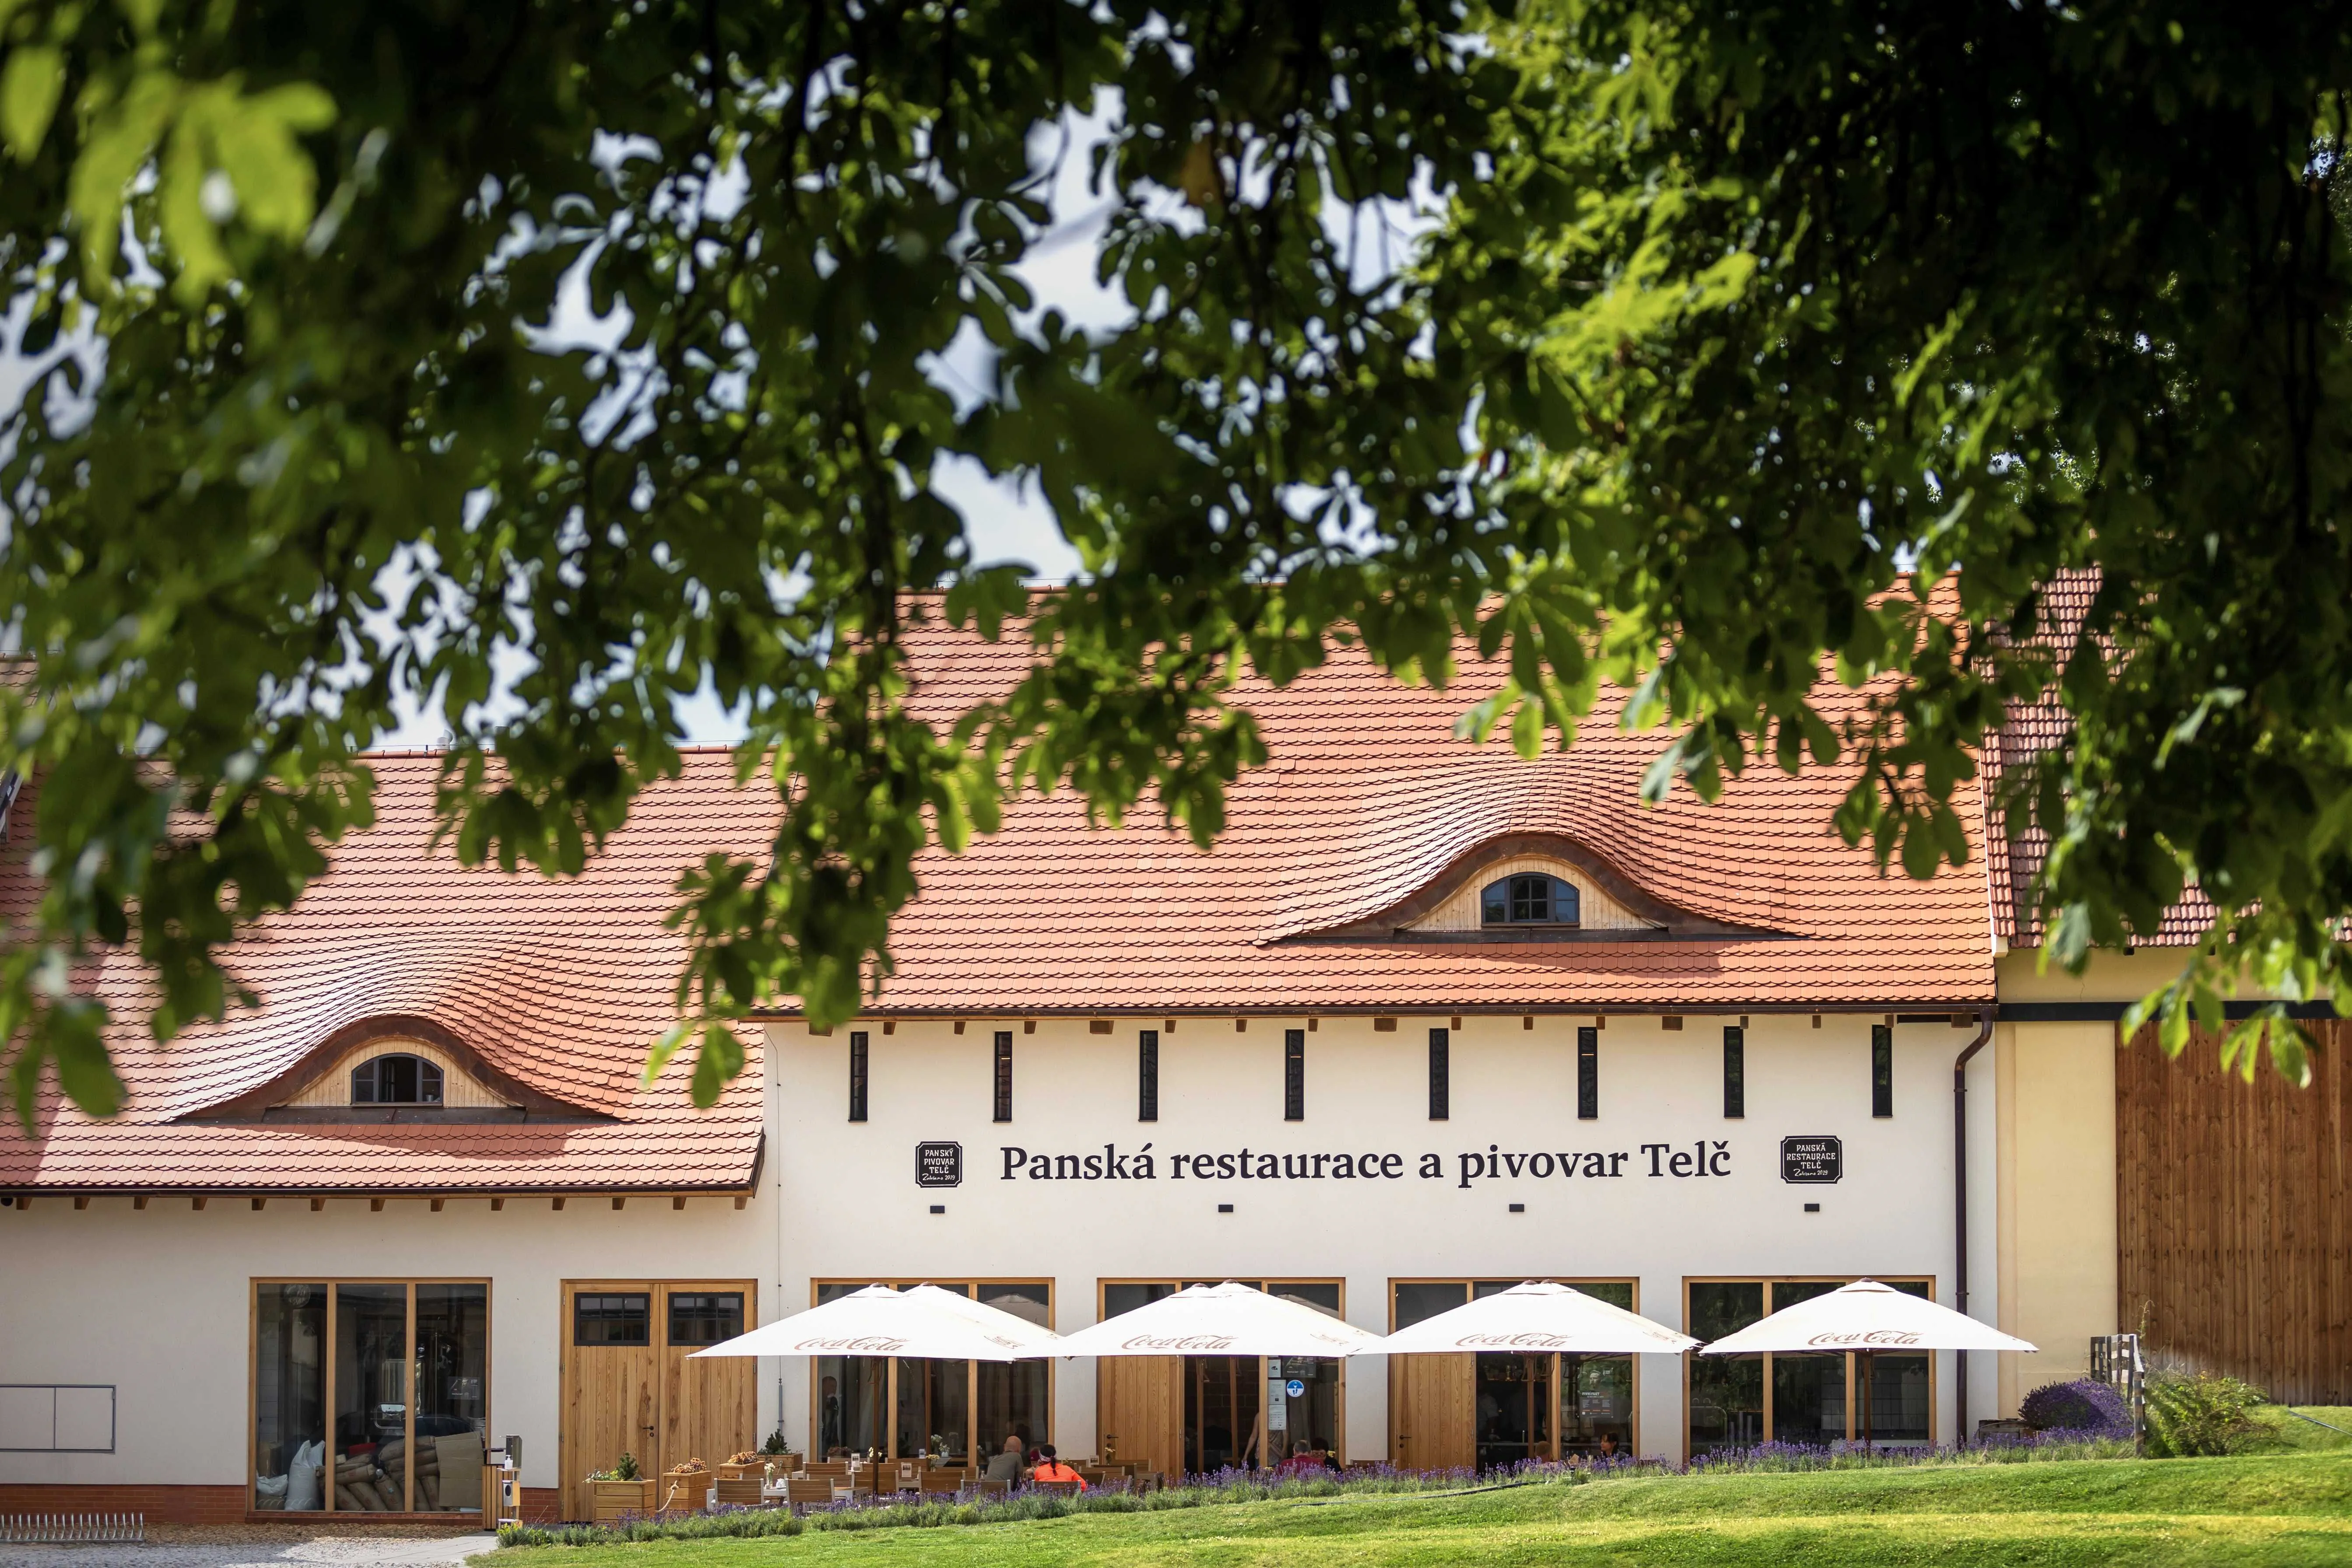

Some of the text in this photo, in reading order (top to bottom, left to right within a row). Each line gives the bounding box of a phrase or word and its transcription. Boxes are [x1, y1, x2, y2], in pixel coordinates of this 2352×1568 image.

[1796, 1142, 1826, 1152] PANSKÁ
[925, 1148, 954, 1157] PANSKÝ
[1000, 1140, 1731, 1188] Panská restaurace a pivovar Telč
[1801, 1160, 1821, 1169] TELČ
[929, 1165, 949, 1174] TELČ
